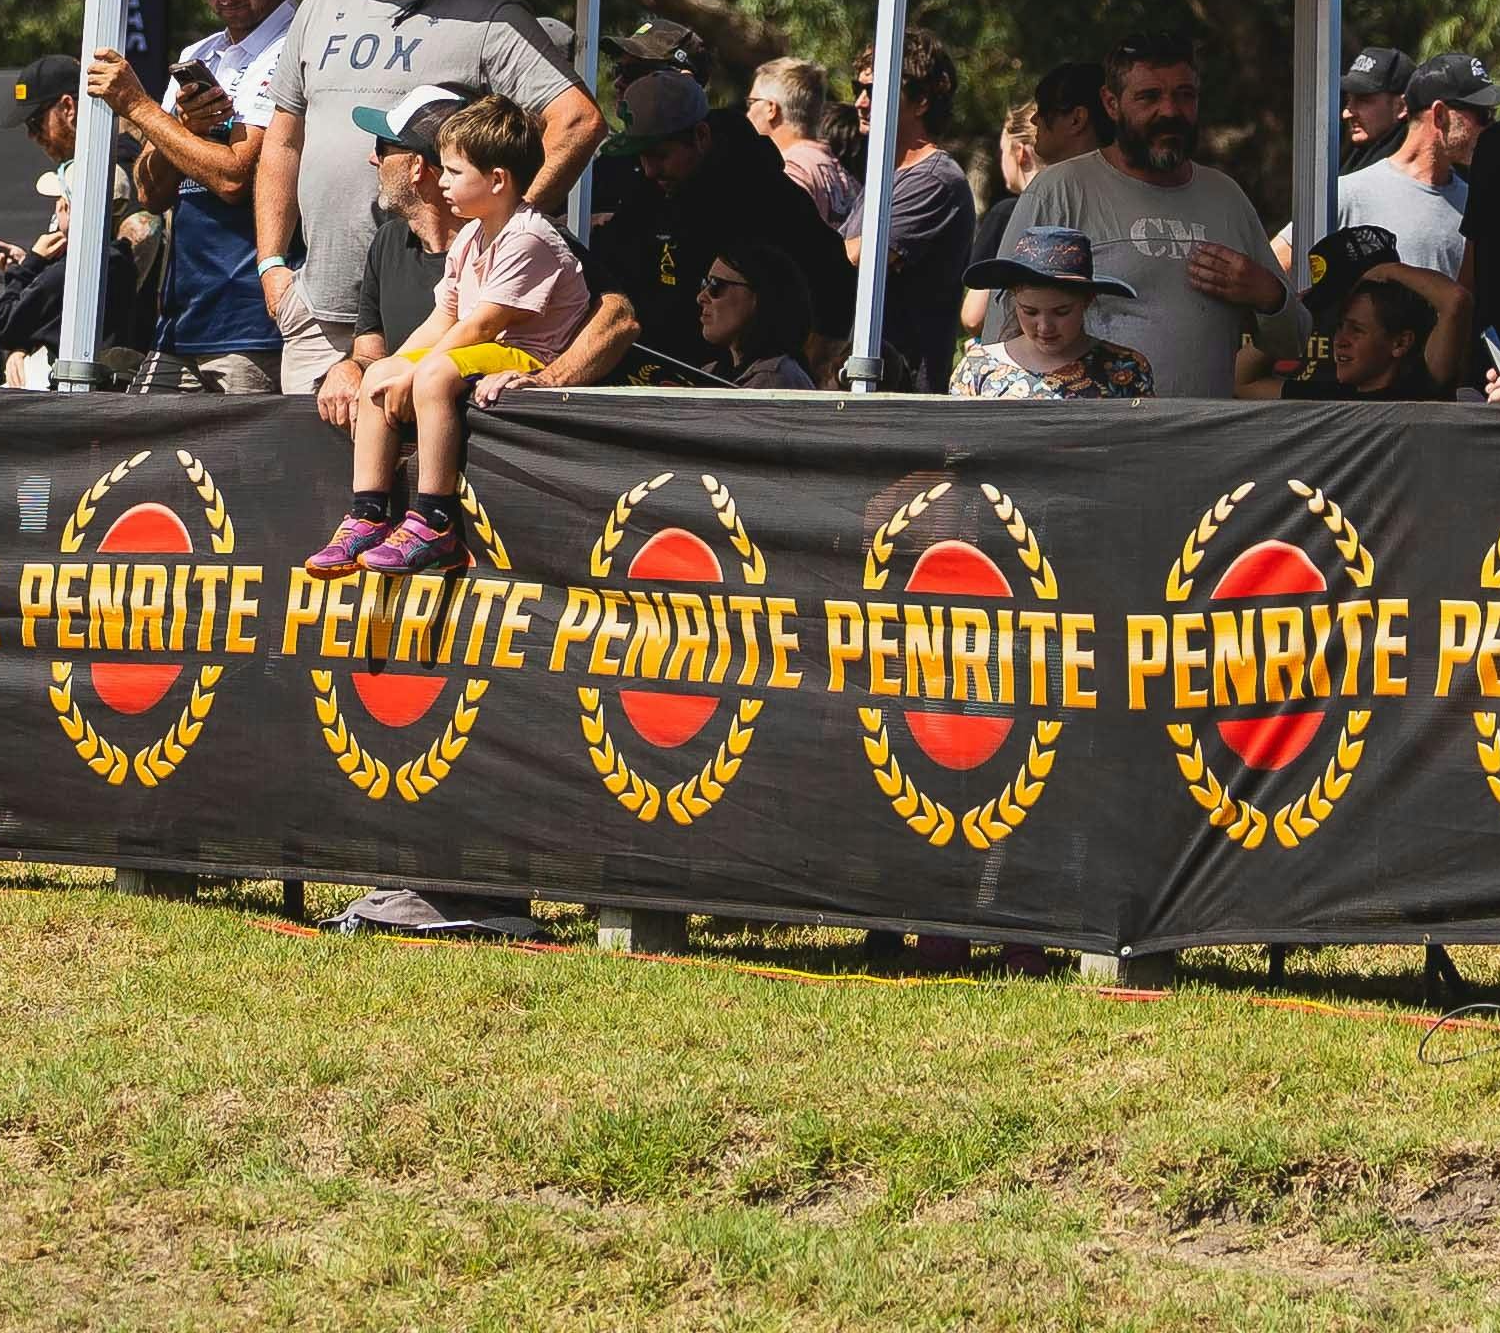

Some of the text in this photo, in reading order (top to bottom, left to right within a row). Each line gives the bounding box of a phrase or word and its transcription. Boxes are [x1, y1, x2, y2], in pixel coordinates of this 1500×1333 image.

[318, 33, 423, 73] FOX
[18, 562, 264, 654] PENRITE
[280, 566, 545, 670] PENRITE
[548, 586, 805, 689] PENRITE
[823, 599, 1098, 710] PENRITE
[1126, 597, 1410, 711] PENRITE
